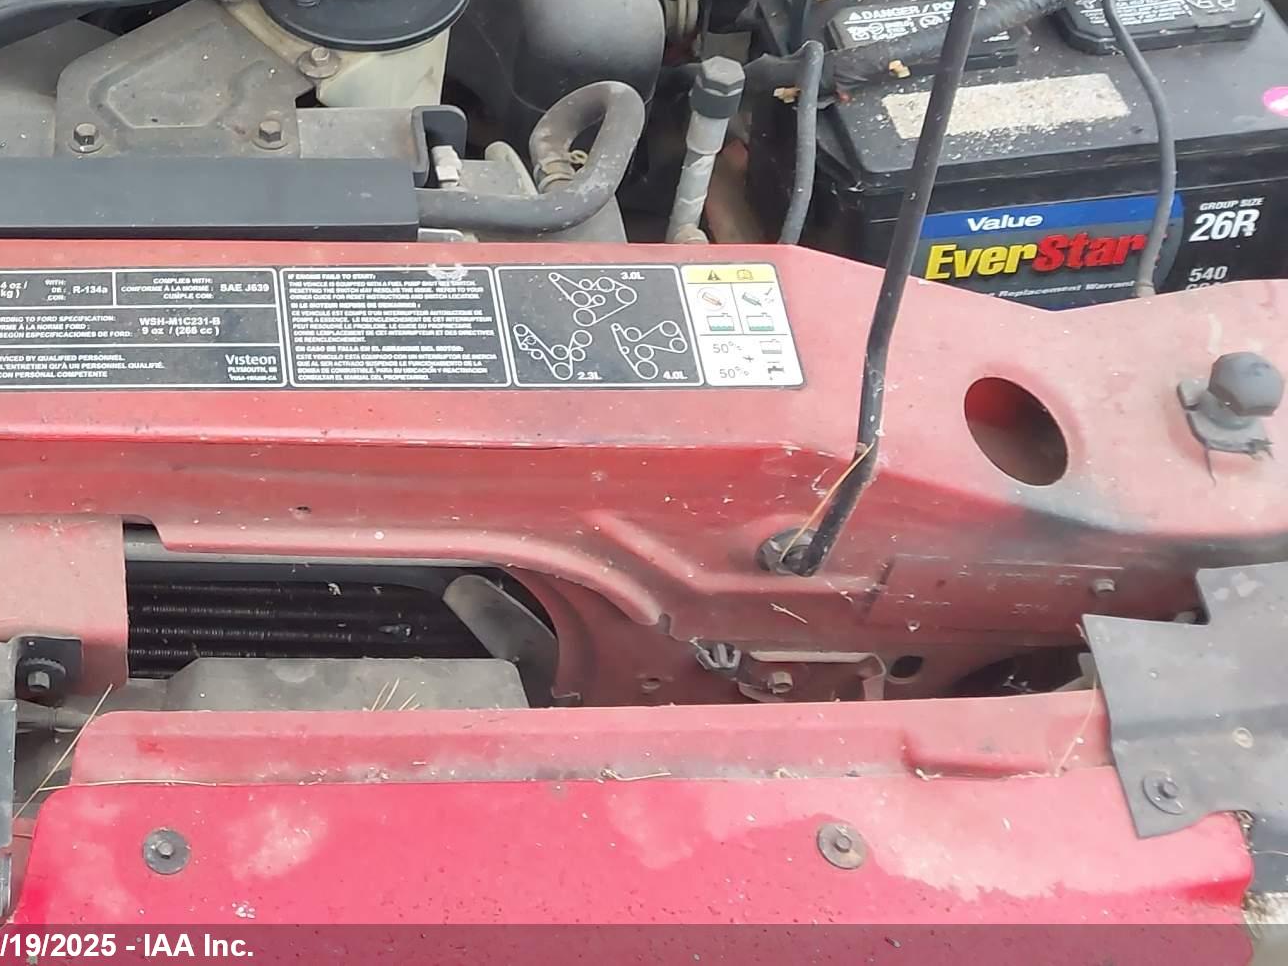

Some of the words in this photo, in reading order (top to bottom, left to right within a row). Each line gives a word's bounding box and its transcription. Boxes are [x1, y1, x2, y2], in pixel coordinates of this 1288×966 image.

[862, 6, 920, 20] DANGER
[1199, 200, 1239, 211] GROUP
[1239, 197, 1264, 208] SIZE
[967, 213, 1043, 232] Value
[1188, 208, 1261, 243] 26R
[925, 230, 1152, 281] EverStar
[1189, 265, 1228, 283] 540
[0, 289, 13, 298] kg
[72, 285, 108, 294] R-134a
[1000, 283, 1082, 298] Replacement
[1085, 280, 1136, 292] Warrant
[138, 317, 221, 326] WSH-M1C231-B
[224, 354, 277, 365] Visteon
